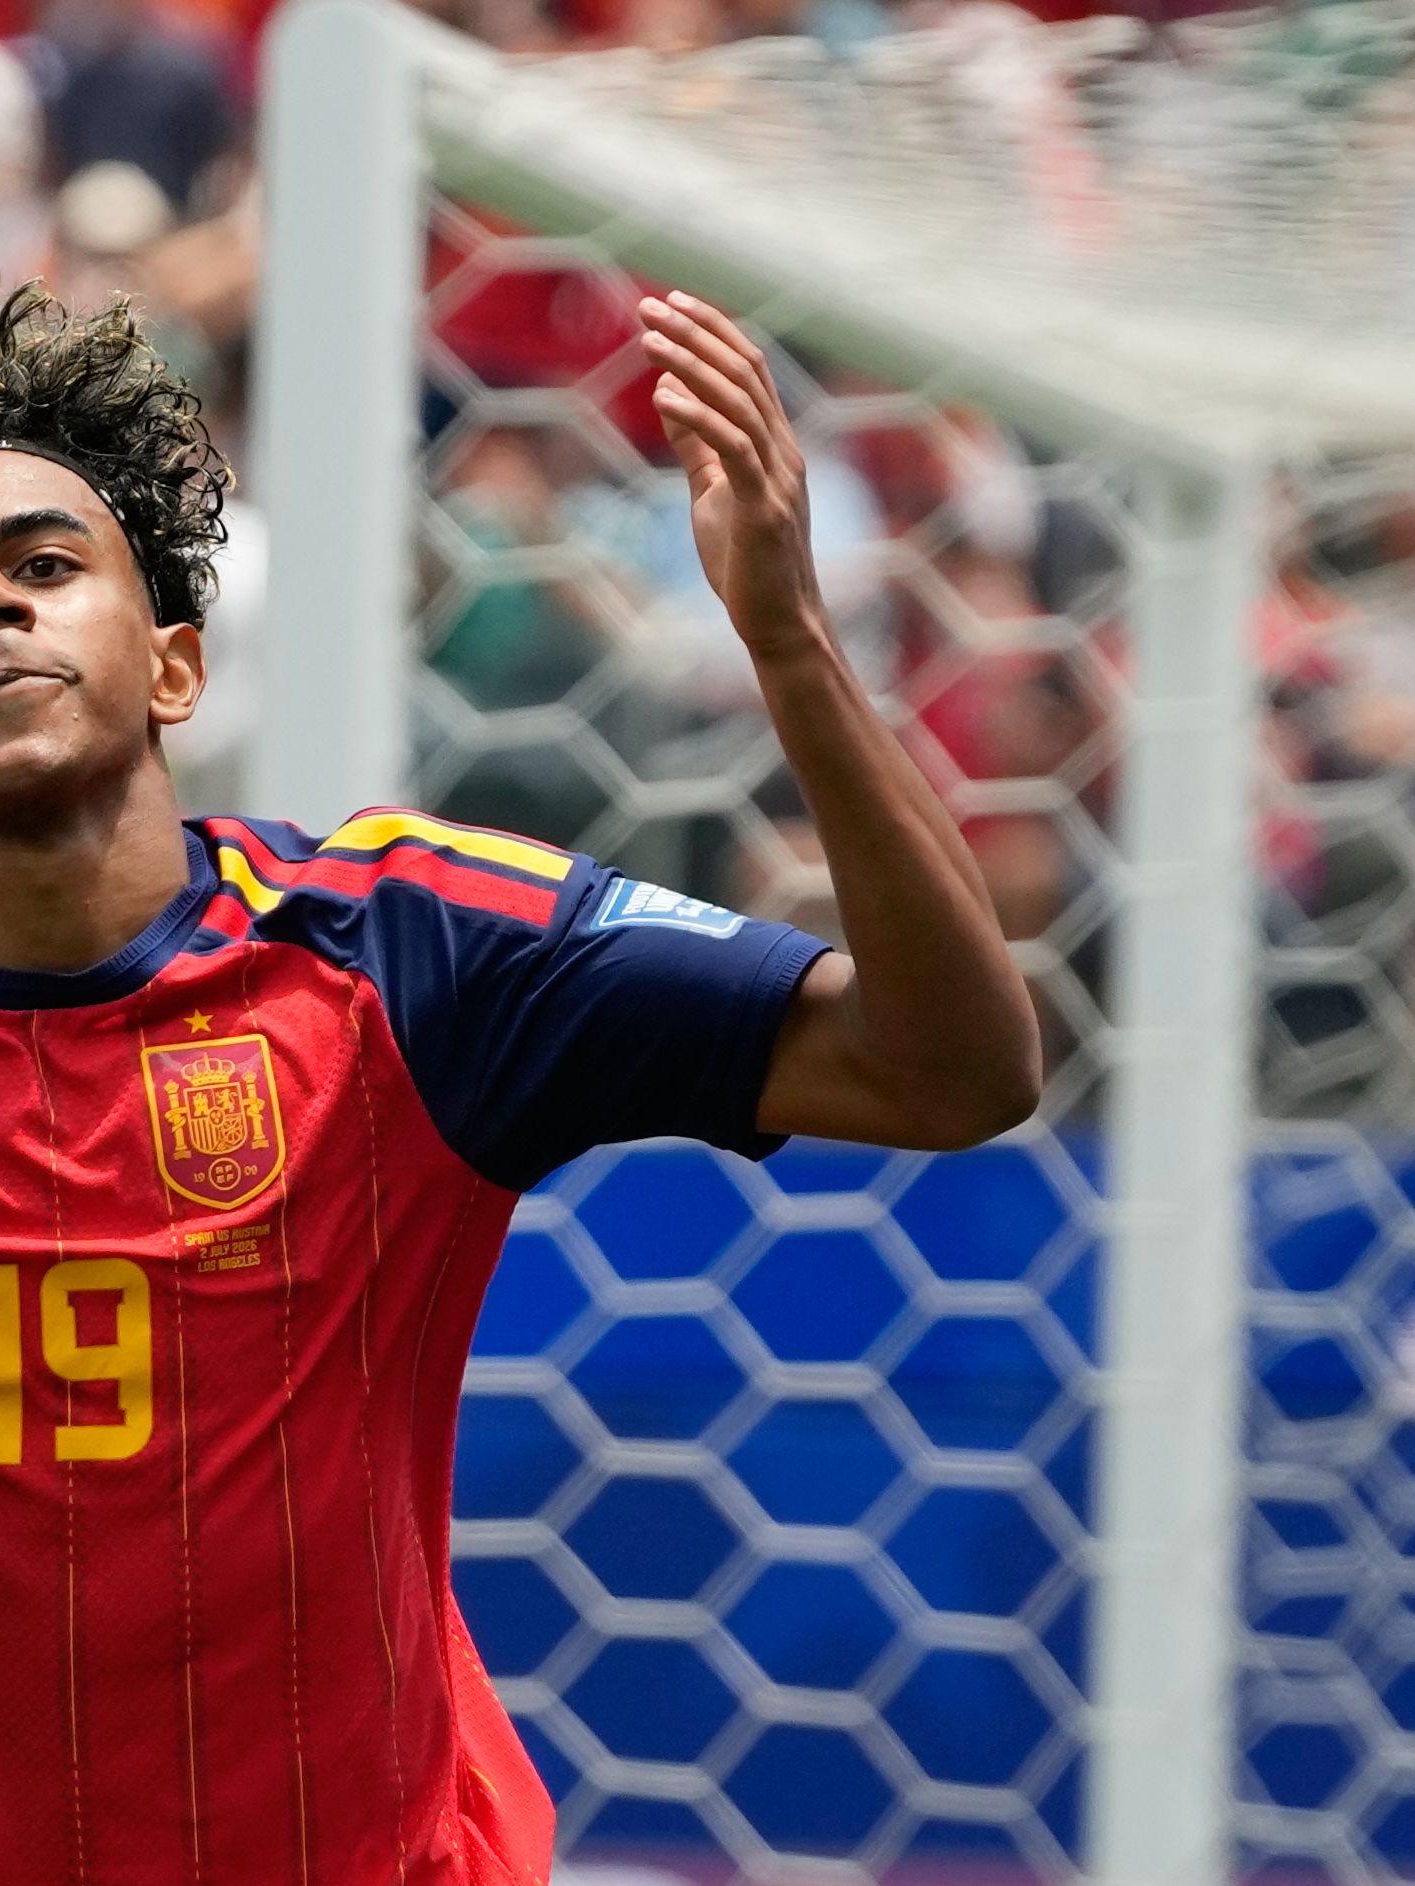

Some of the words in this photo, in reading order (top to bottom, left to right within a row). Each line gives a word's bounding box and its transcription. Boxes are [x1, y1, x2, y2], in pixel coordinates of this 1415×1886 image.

[185, 1231, 214, 1246] SPAIN
[232, 1224, 270, 1240] AUSTRIA
[200, 1247, 207, 1258] 2
[210, 1244, 229, 1257] JULY
[232, 1239, 257, 1253] 2026
[198, 1260, 216, 1272] LOS
[218, 1252, 261, 1270] ANGELES
